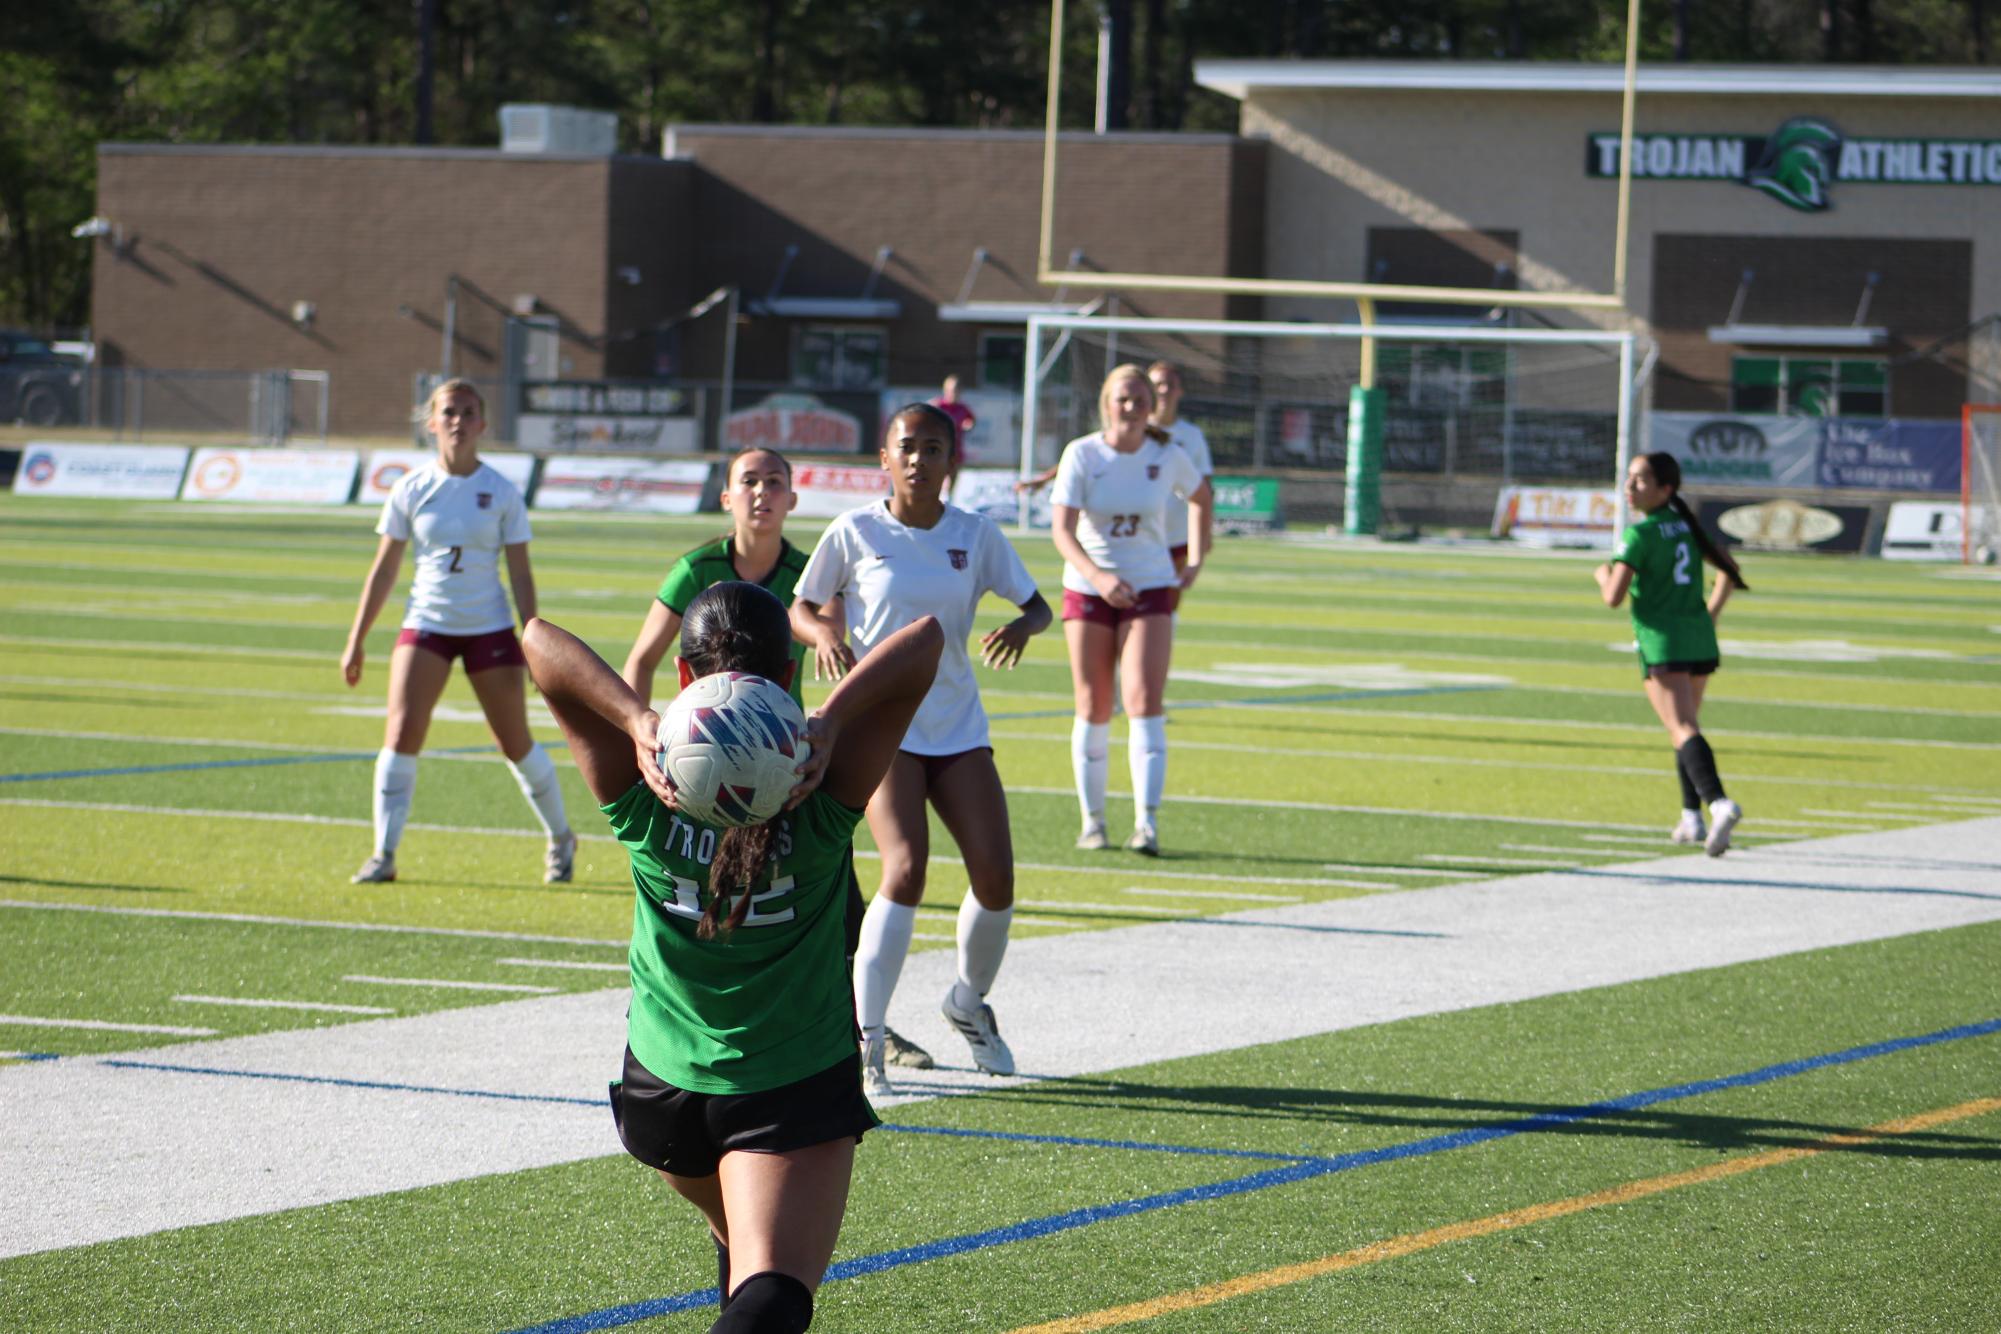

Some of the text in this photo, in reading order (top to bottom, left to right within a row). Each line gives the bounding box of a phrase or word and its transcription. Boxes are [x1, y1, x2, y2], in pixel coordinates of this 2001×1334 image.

[1594, 137, 1745, 178] TROJAN
[1110, 513, 1141, 538] 23
[449, 545, 464, 574] 2
[1673, 541, 1692, 585] 2
[664, 814, 793, 866] TROS
